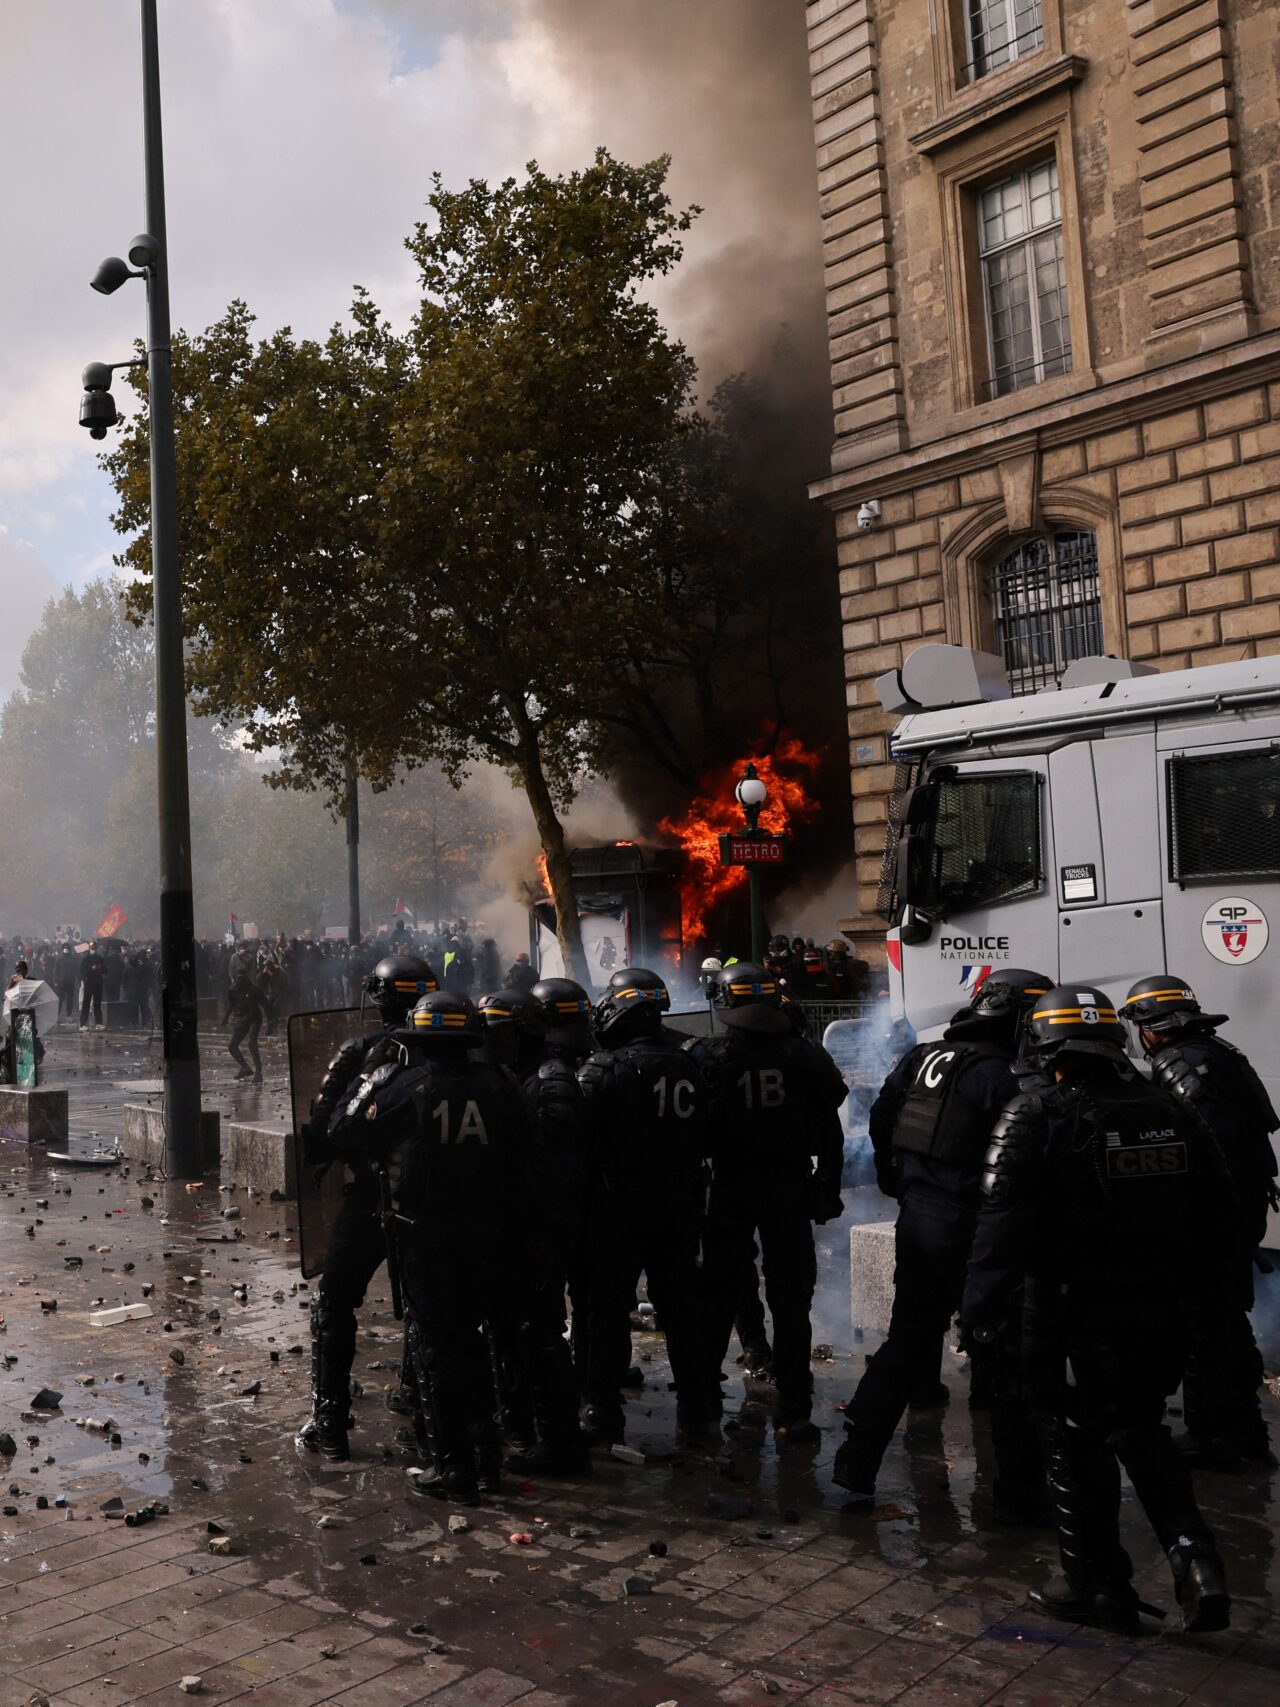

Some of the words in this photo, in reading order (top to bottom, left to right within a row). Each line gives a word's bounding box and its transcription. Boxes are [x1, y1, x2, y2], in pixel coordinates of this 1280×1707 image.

[733, 844, 780, 859] METRO
[1065, 867, 1089, 875] RENAULT
[941, 937, 1009, 950] POLICE
[431, 1014, 442, 1024] 21
[1084, 1010, 1098, 1020] 21
[737, 1069, 785, 1108] 1B
[654, 1076, 695, 1118] 1C
[432, 1099, 488, 1144] 1A
[1140, 1129, 1176, 1140] LAPLACE
[1116, 1148, 1180, 1173] CRS
